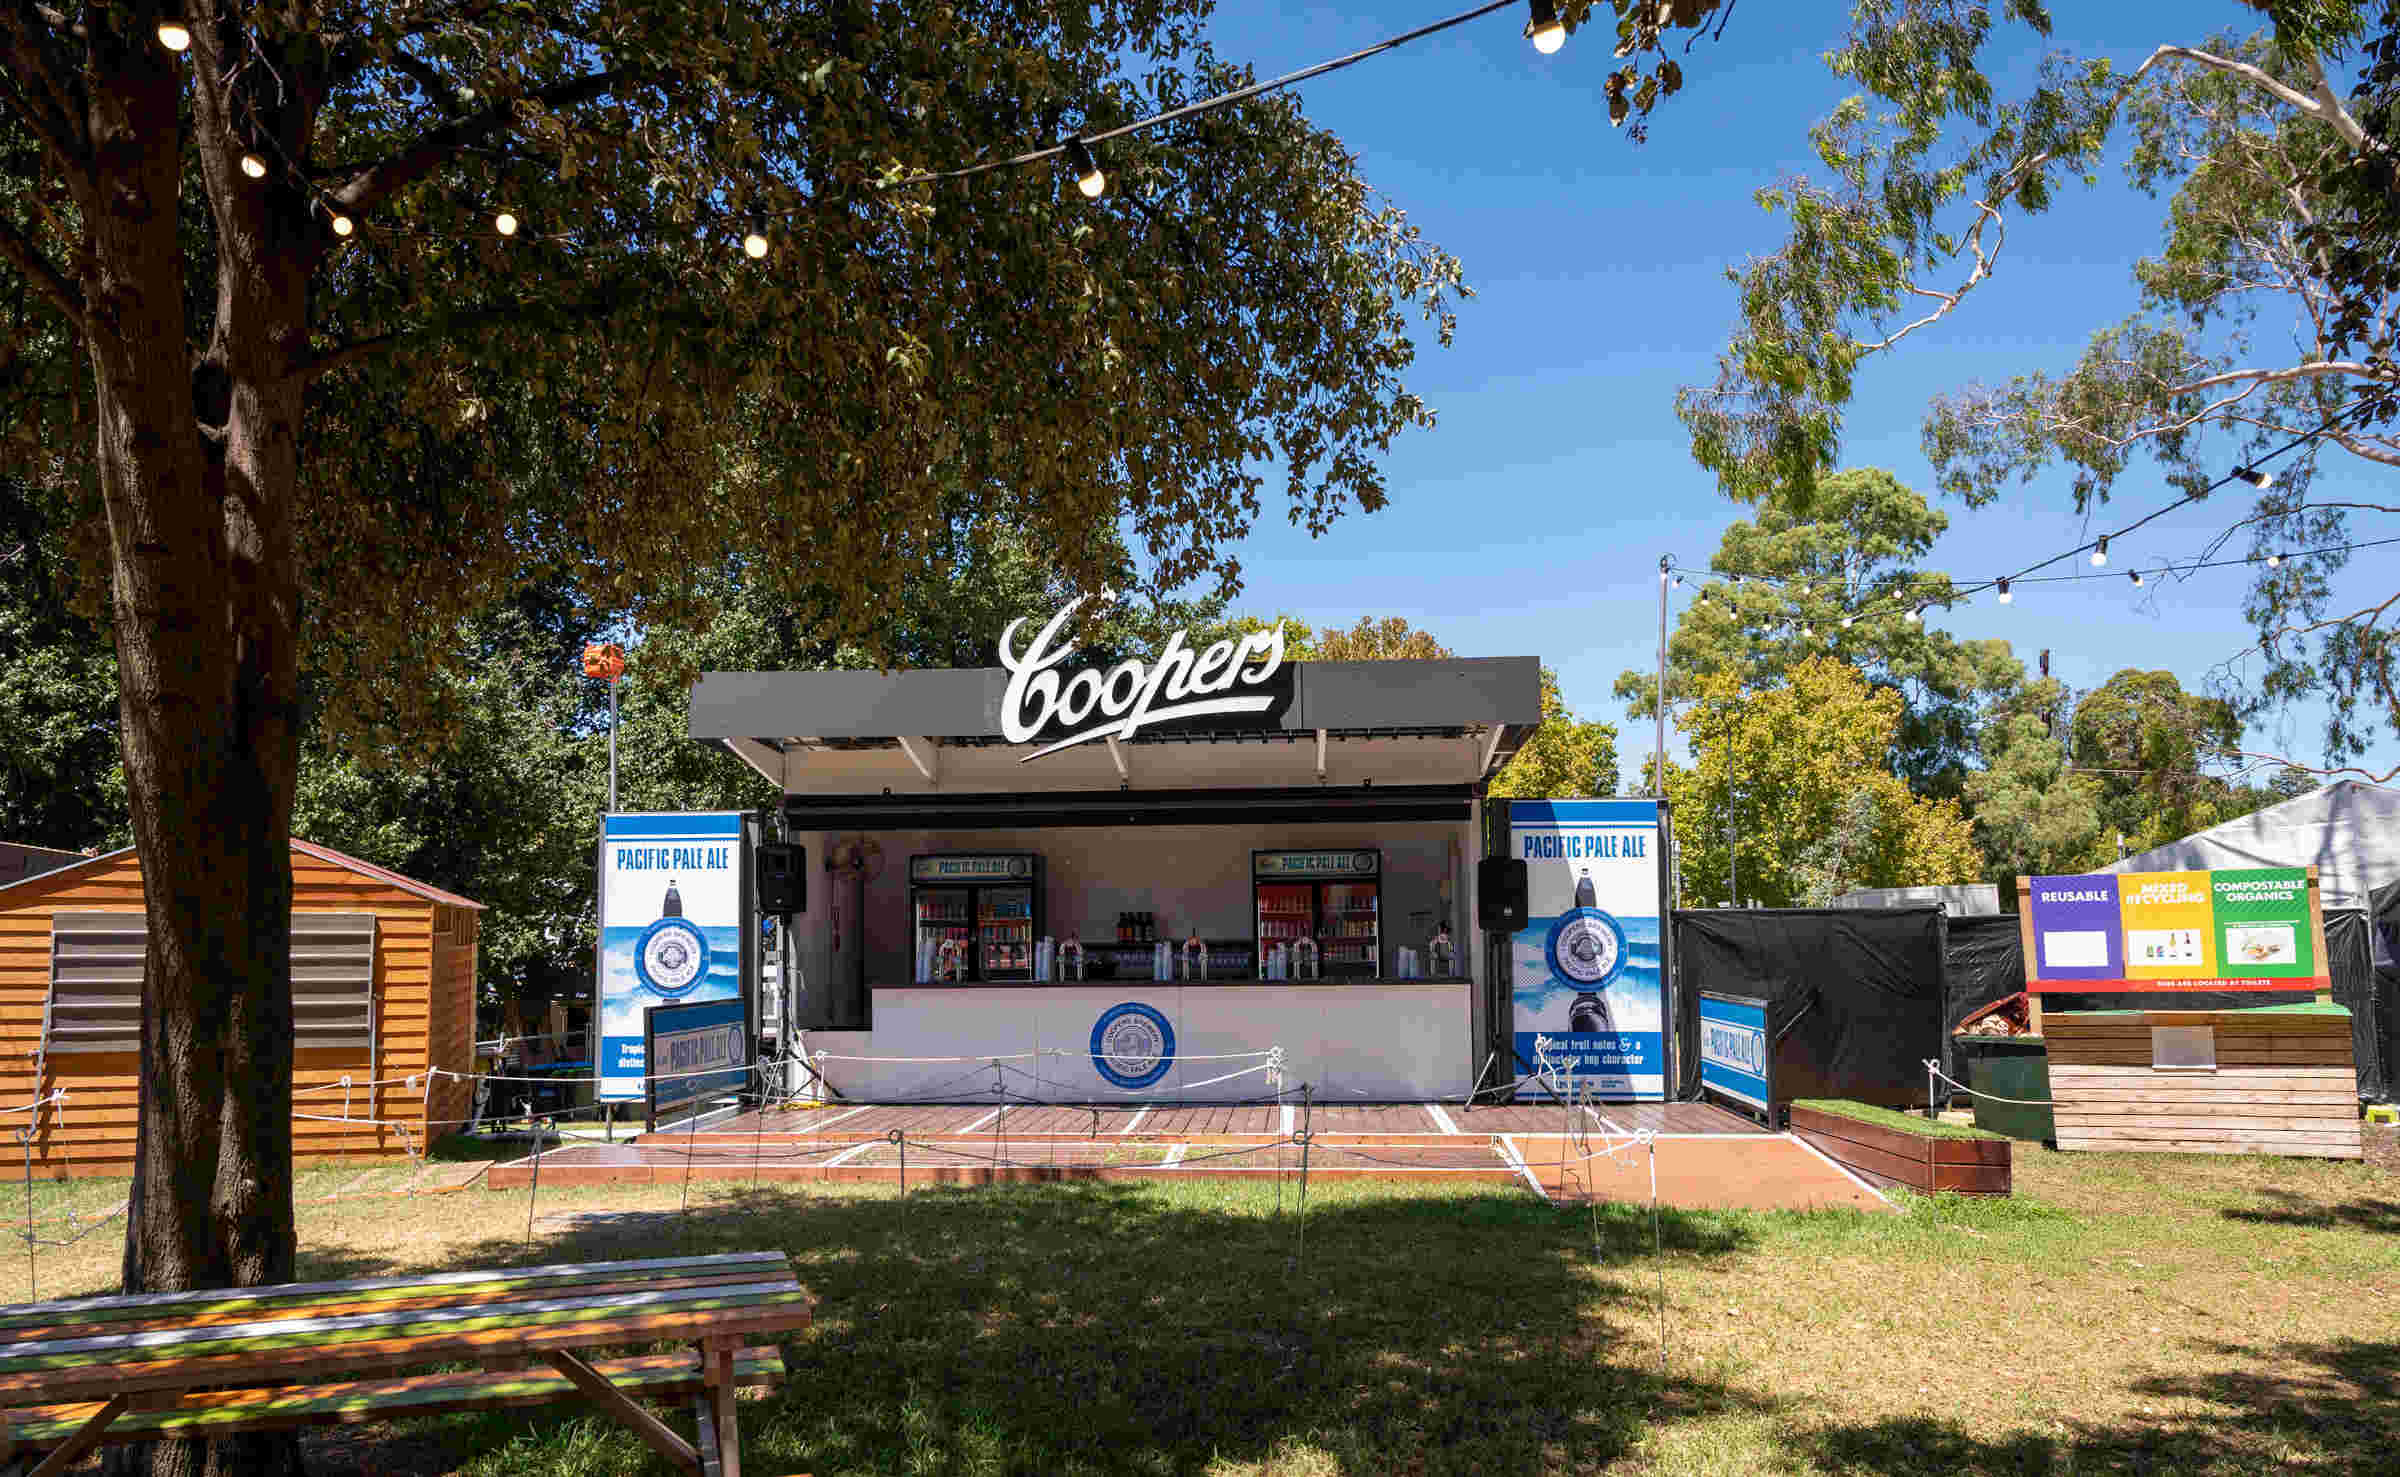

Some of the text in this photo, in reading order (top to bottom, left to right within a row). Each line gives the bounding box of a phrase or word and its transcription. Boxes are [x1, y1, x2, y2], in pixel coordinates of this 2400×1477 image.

[999, 586, 1287, 744] Coopers
[1524, 835, 1646, 858] PACIFIC PALE ALE
[617, 847, 728, 870] PACIFIC PALE ALE
[2213, 880, 2305, 892] COMPOSTABLE
[2041, 890, 2108, 902] REUSABLE
[2226, 891, 2294, 902] ORGANICS
[1619, 1037, 1631, 1051] &
[1603, 1055, 1643, 1064] character
